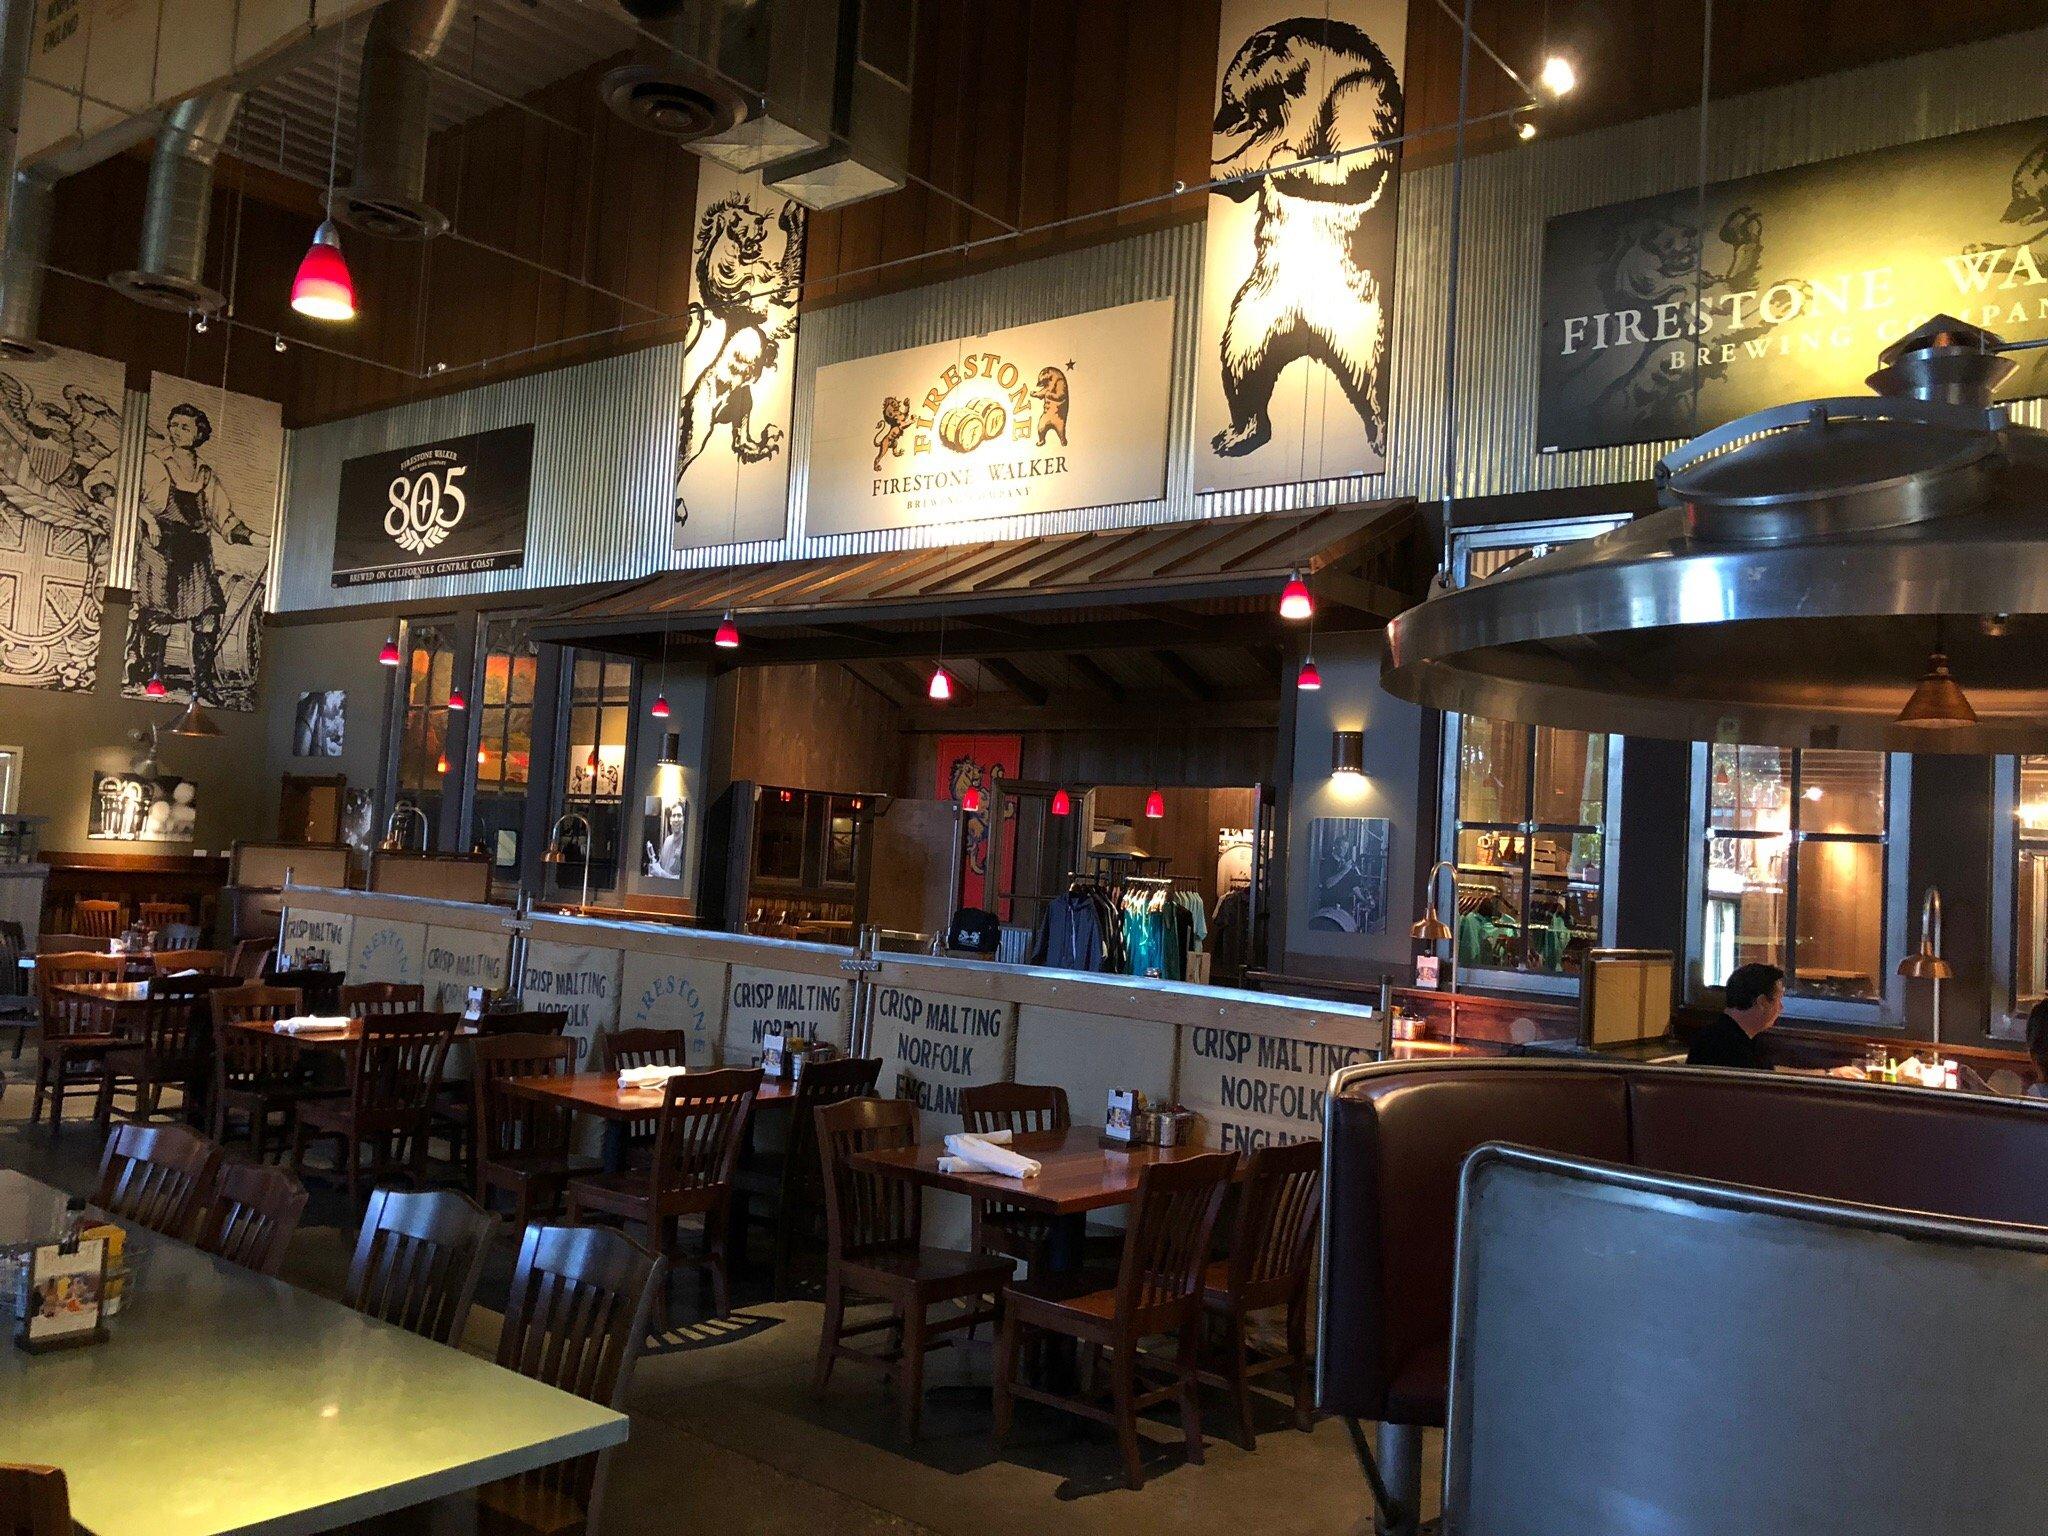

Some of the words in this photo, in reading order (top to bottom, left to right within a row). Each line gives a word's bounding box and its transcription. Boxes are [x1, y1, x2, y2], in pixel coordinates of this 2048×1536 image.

[1560, 267, 1894, 356] FIRESTONE
[1669, 327, 1854, 371] BREWING
[914, 352, 1032, 456] FIRESTONE
[988, 456, 1069, 482] WALKER
[384, 466, 467, 536] 805
[349, 572, 375, 583] BREWED
[436, 560, 469, 573] CENTRAL
[471, 557, 495, 570] COAST
[525, 968, 553, 993] CRISP
[555, 971, 607, 999] MALTING
[734, 982, 773, 1009] CRISP
[776, 983, 841, 1012] MALTING
[879, 988, 922, 1024] CRISP
[926, 1002, 1002, 1037] MALTING
[897, 1032, 974, 1076] NORFOLK
[1192, 1027, 1251, 1064] CRISP
[1221, 1074, 1325, 1125] NORFOLK
